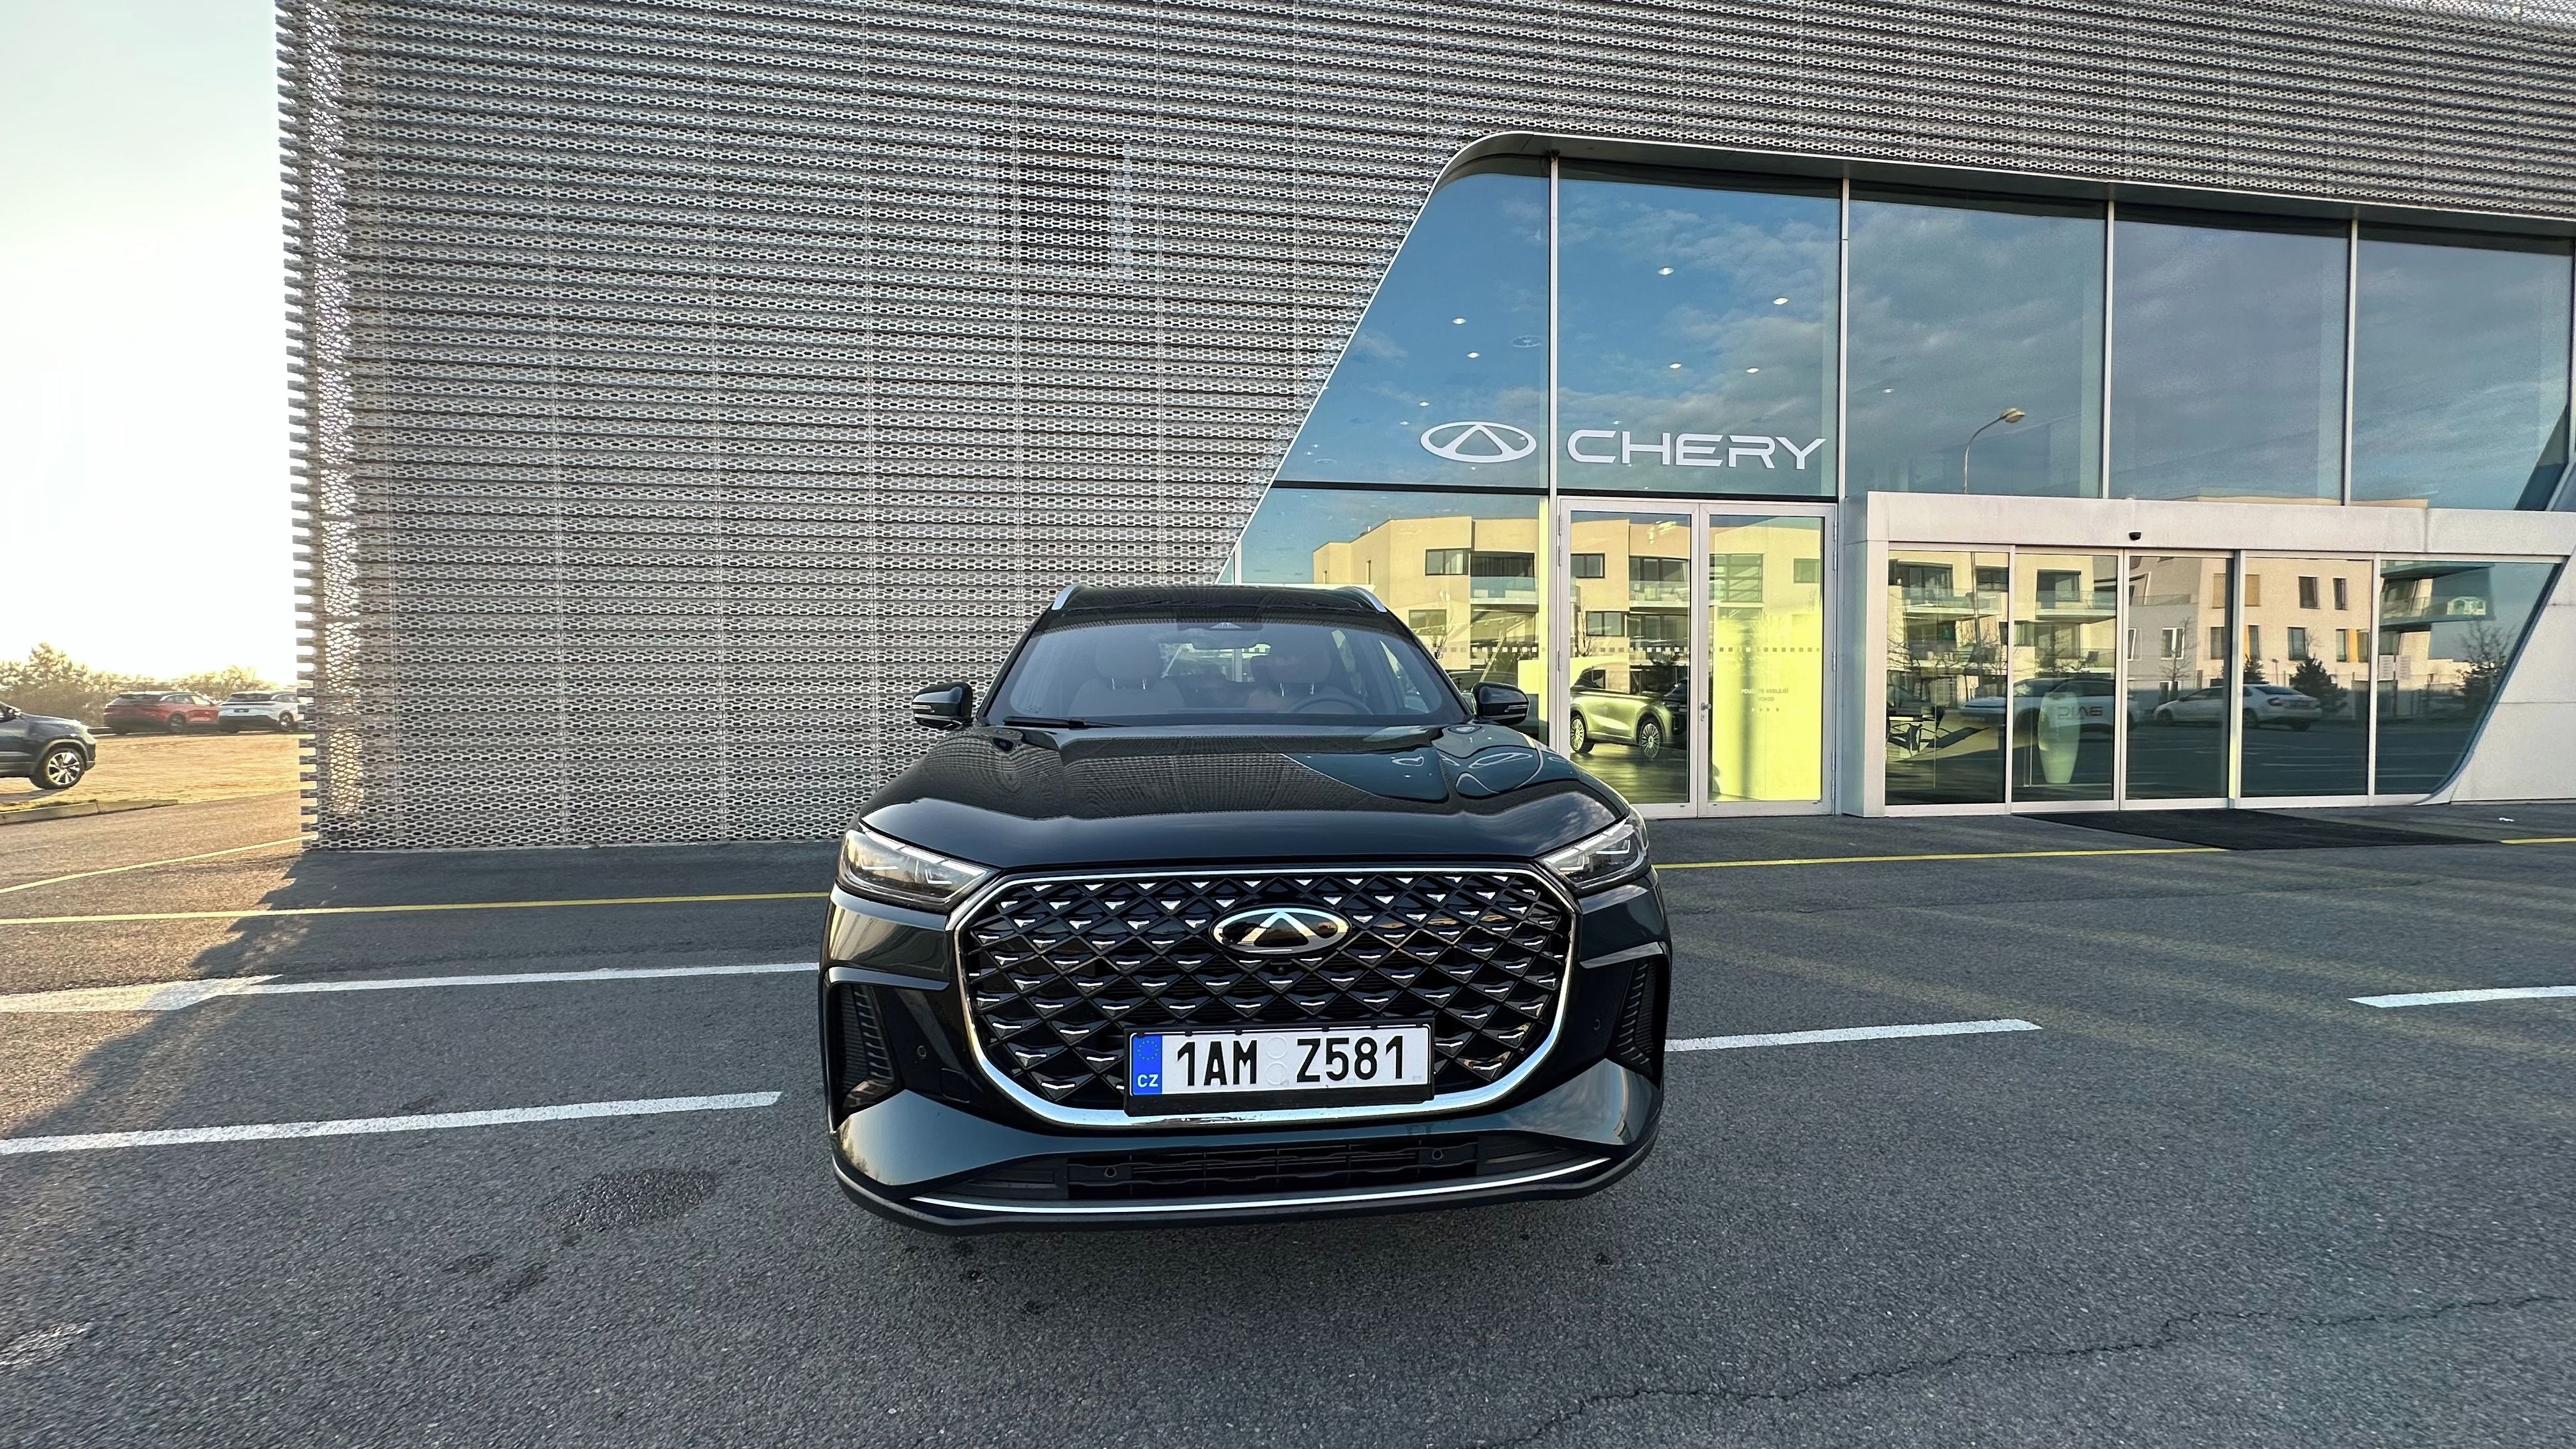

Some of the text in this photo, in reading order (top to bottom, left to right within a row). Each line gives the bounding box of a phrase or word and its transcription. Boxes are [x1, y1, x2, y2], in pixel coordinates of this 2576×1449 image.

[1567, 429, 1827, 470] CHERY
[1137, 1073, 1159, 1088] CZ
[1177, 1035, 1404, 1087] 1AM Z581
